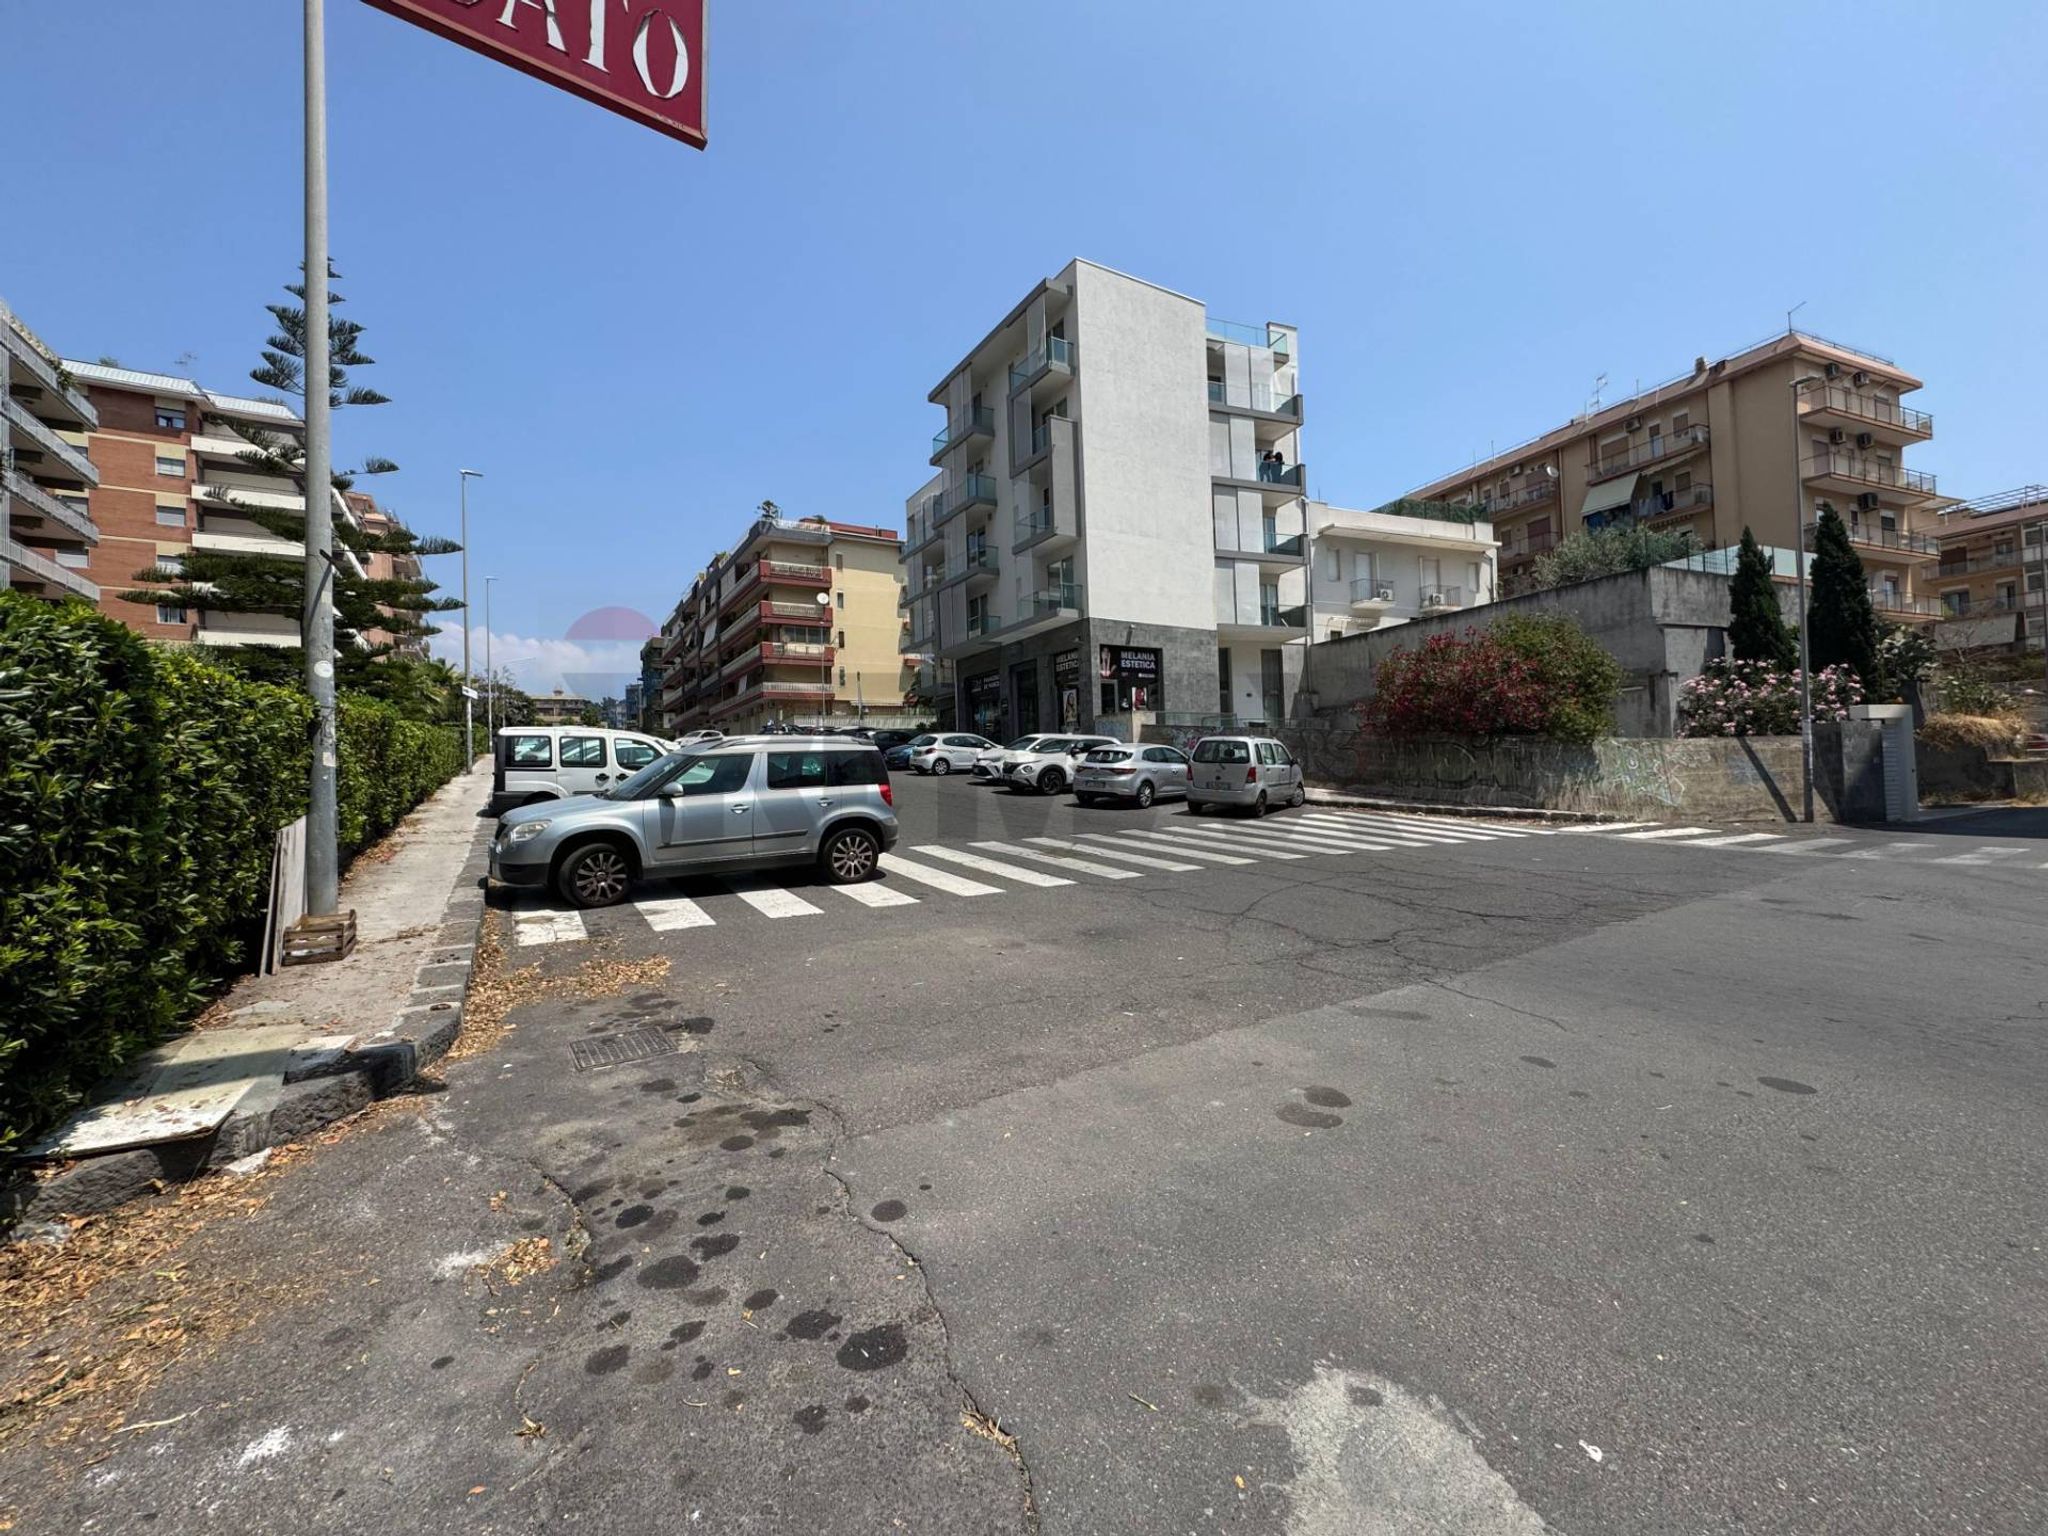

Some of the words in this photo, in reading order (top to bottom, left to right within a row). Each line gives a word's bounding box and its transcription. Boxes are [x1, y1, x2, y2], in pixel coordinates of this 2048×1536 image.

[453, 0, 689, 99] ATO
[1120, 650, 1156, 661] MELANIA
[1120, 659, 1156, 669] ESTETICA
